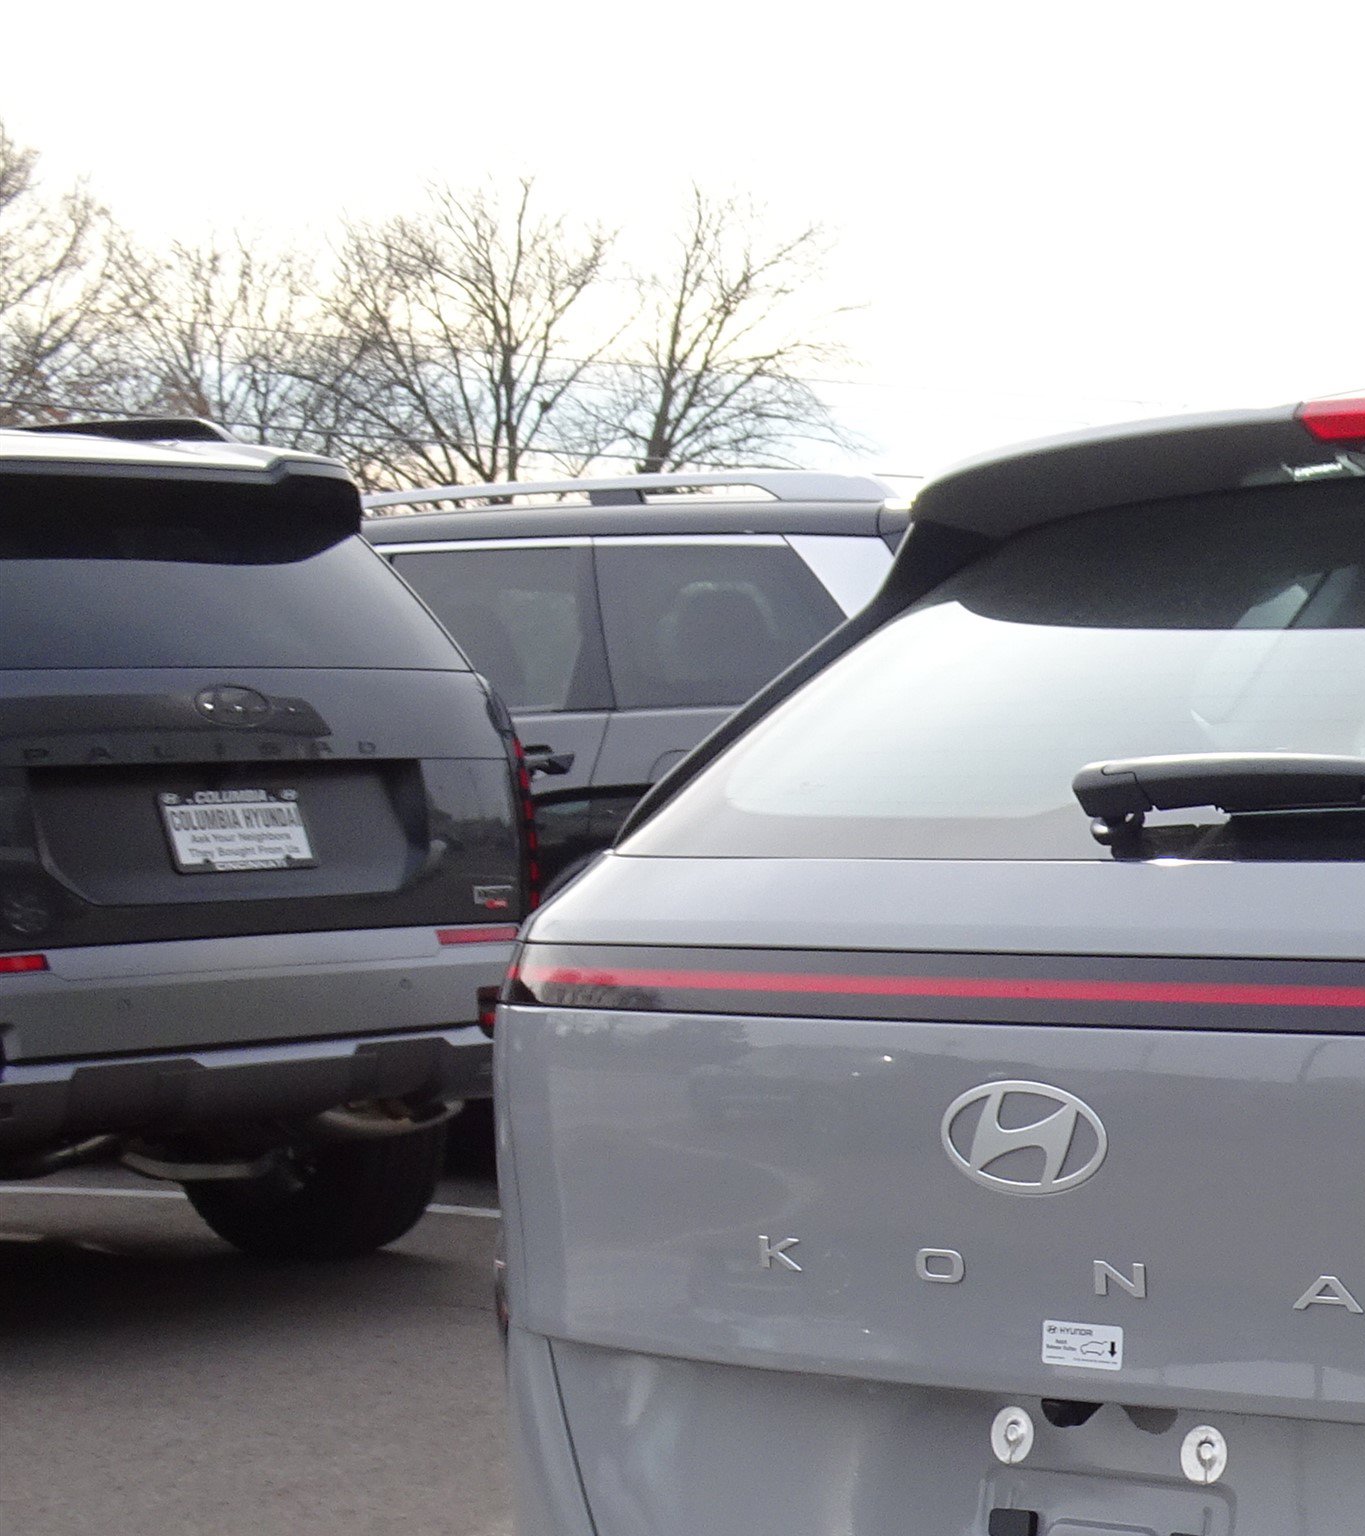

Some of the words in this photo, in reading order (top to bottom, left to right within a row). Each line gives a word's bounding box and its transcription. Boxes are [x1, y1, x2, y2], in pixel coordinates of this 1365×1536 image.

[170, 808, 243, 831] COLUMBIA
[242, 807, 304, 828] HYUNDAI
[758, 1235, 1364, 1314] KONA
[1060, 1326, 1094, 1337] HYUNDAI
